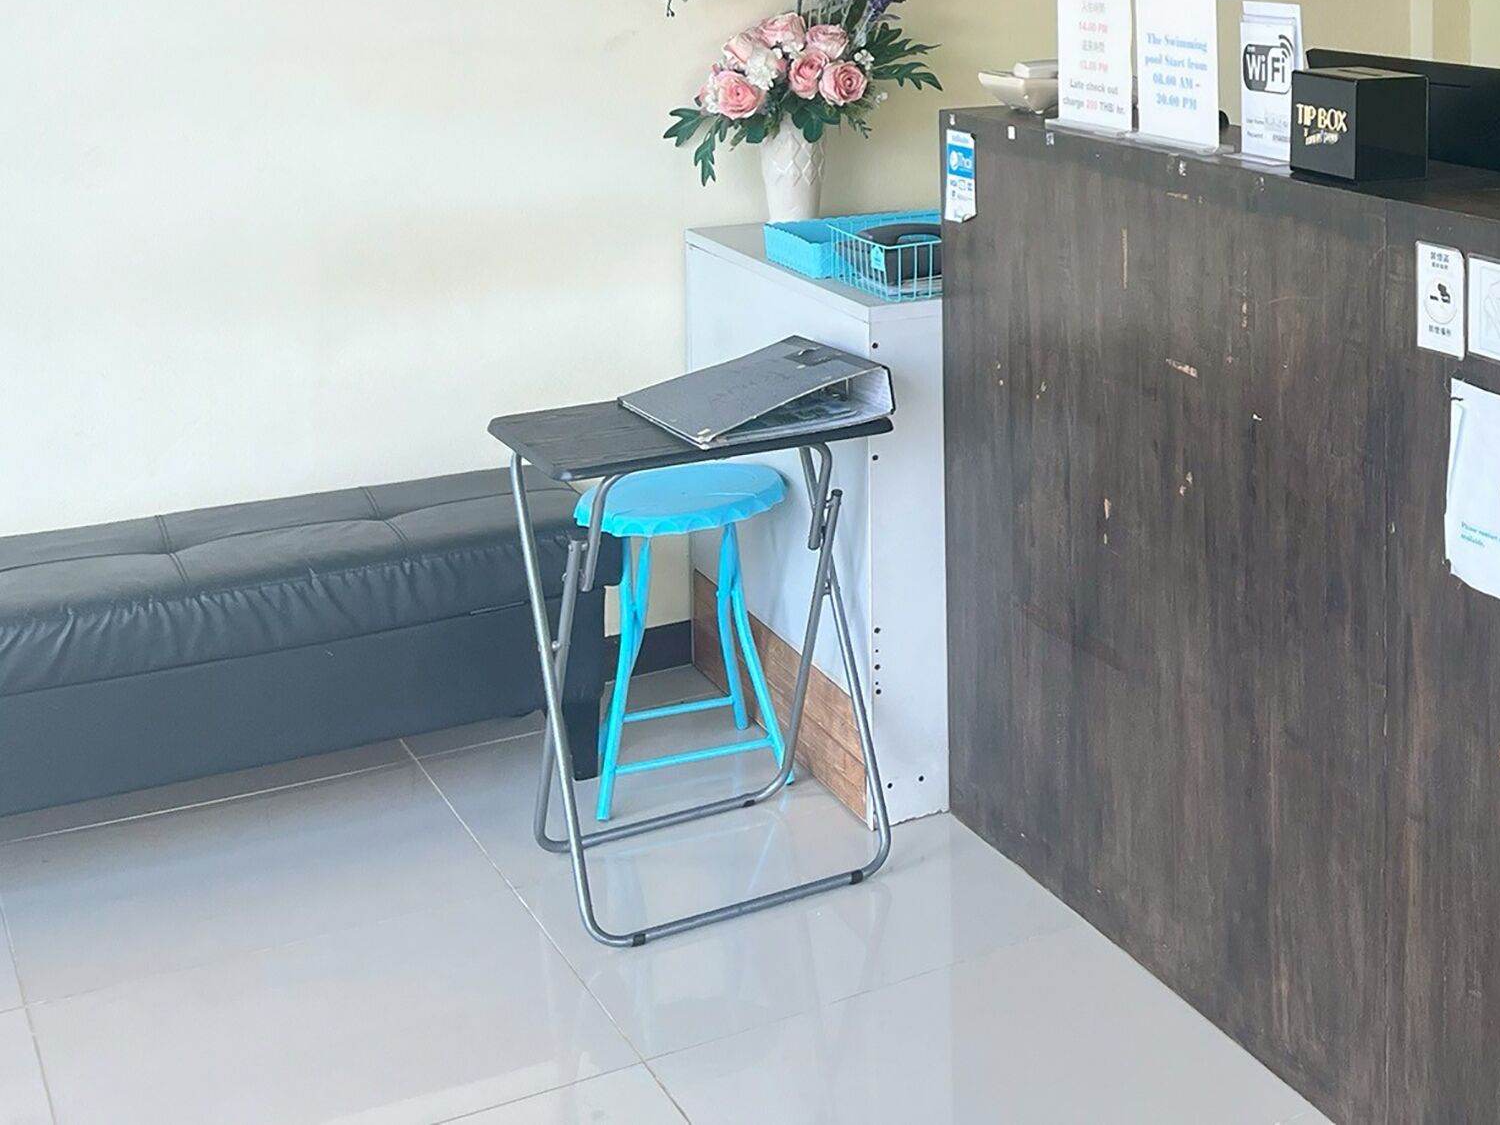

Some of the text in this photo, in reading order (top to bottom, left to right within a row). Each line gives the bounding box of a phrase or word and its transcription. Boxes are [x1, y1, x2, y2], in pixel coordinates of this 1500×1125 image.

[1146, 31, 1208, 53] The Swimming
[1145, 53, 1163, 67] pool
[1164, 55, 1185, 68] Start
[1180, 75, 1193, 90] AM
[1182, 96, 1197, 111] PM
[1296, 103, 1348, 133] TIP BOX
